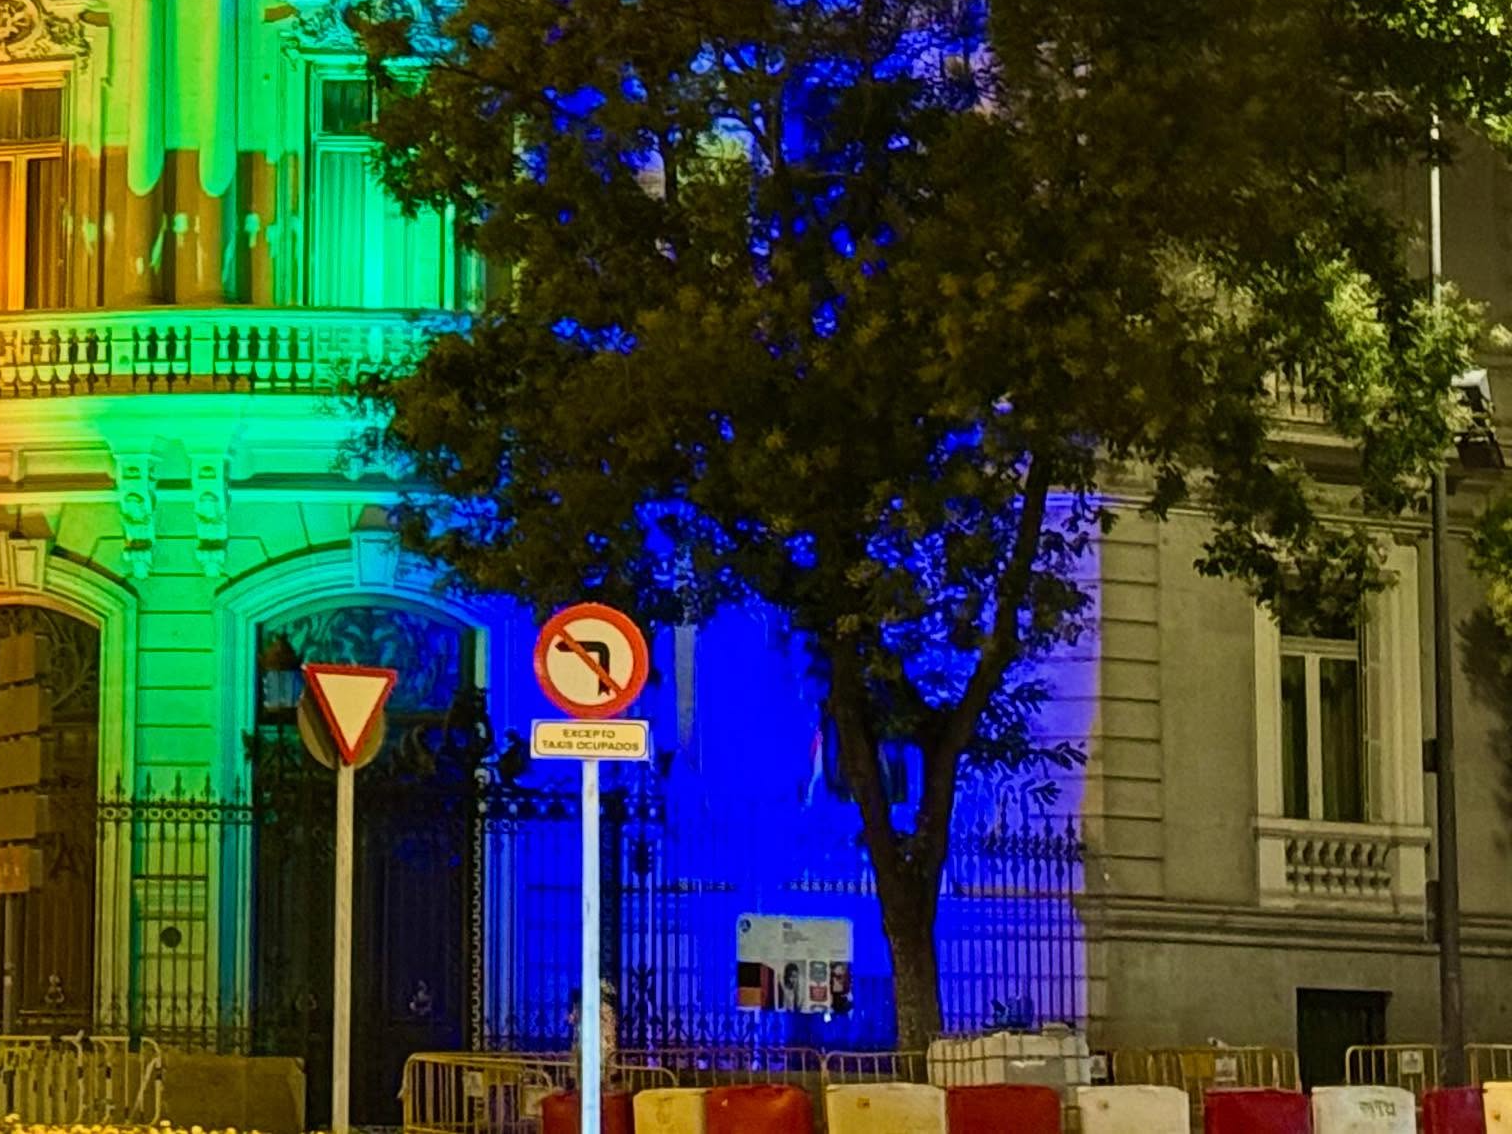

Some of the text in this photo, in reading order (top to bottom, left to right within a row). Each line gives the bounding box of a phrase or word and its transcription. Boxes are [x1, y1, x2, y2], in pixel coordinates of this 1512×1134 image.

[562, 729, 616, 739] EXCEPTO
[542, 740, 640, 751] TAXIS OCUPADOS
